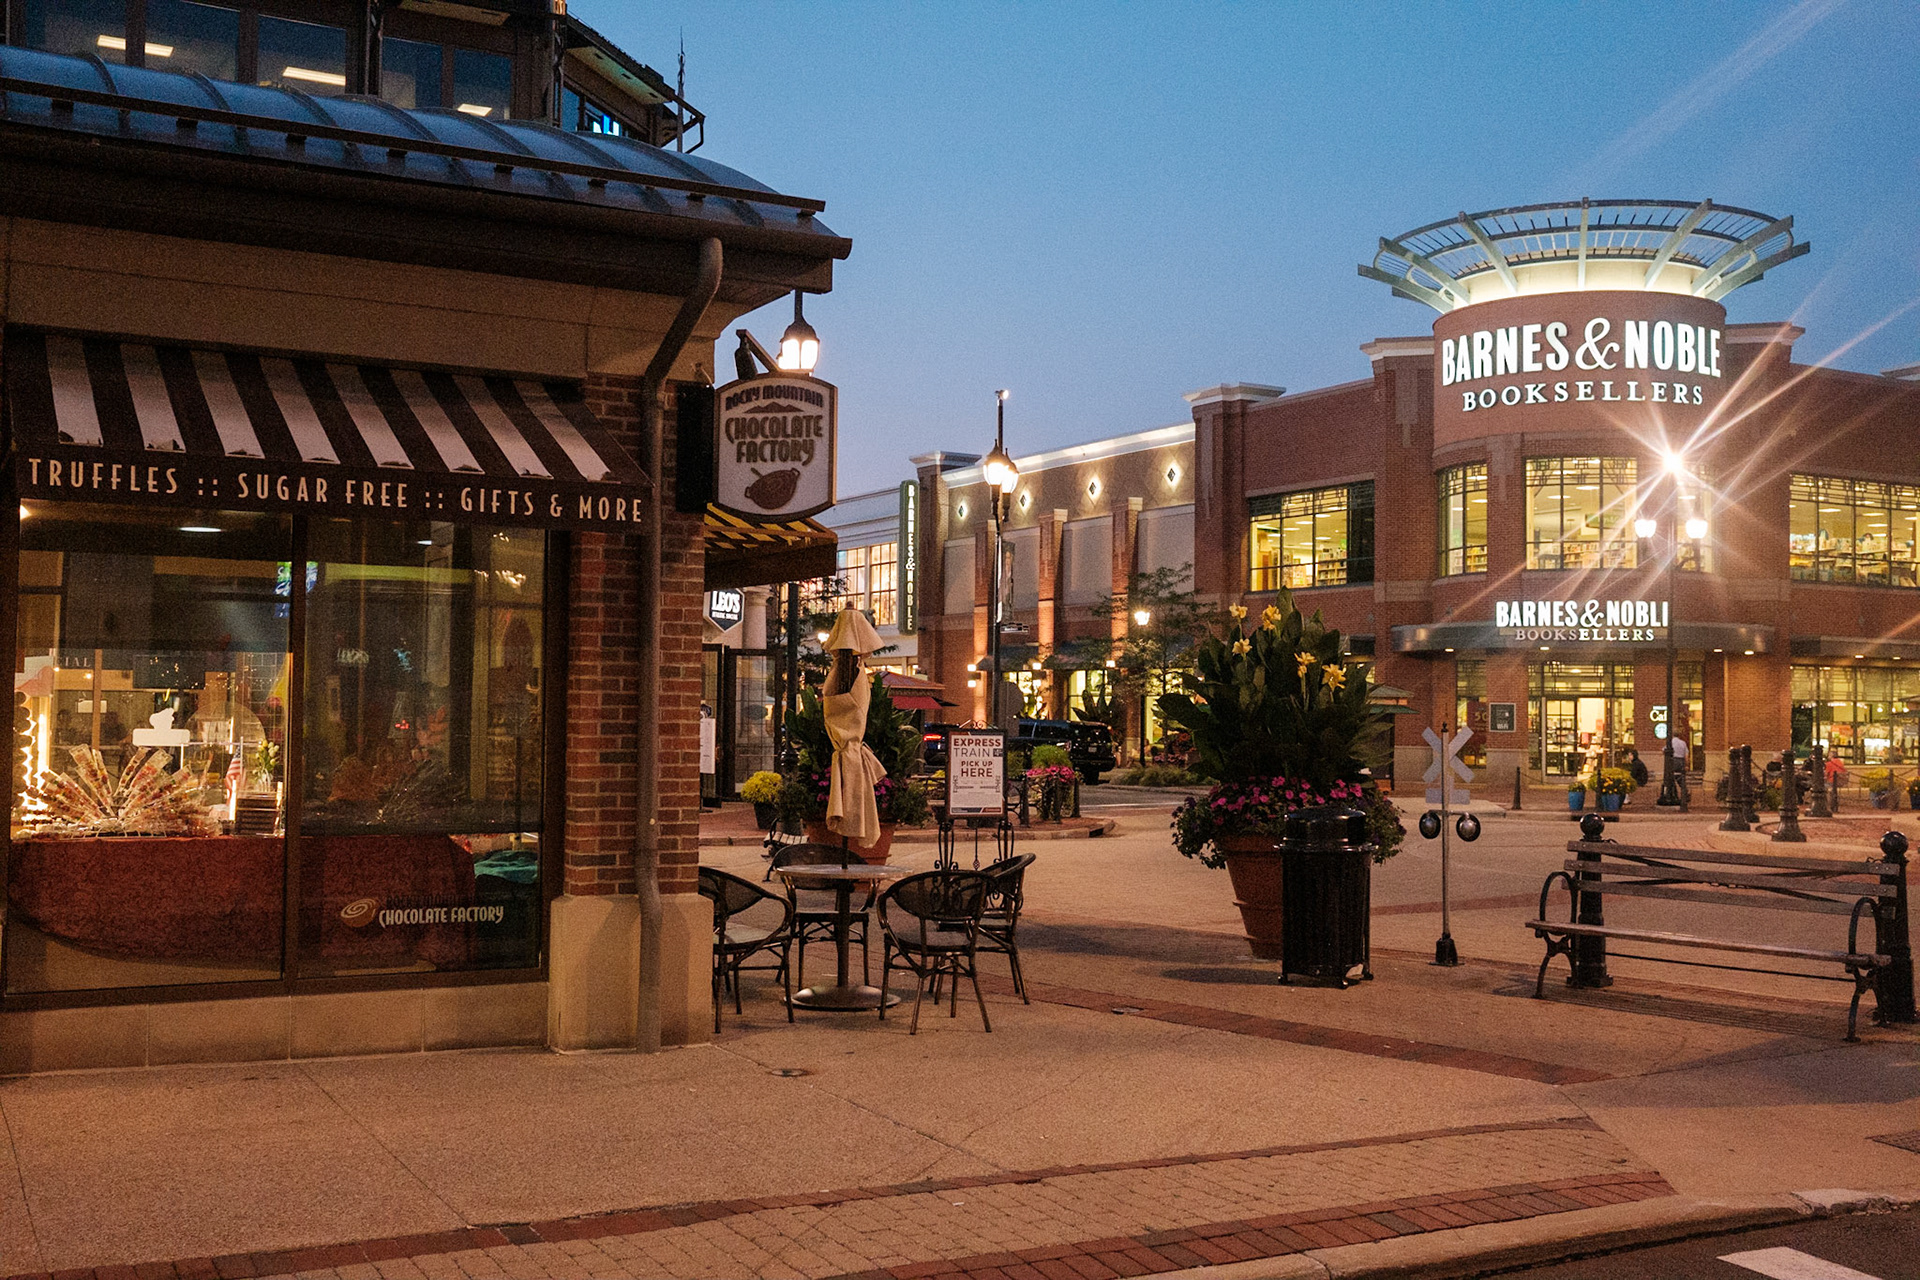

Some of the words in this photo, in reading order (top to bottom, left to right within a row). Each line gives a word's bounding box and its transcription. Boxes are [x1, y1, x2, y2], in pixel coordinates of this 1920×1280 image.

[725, 386, 760, 412] ROCKY
[762, 384, 824, 408] MOUNTAIN
[1462, 381, 1703, 412] BOOKSELLERS
[725, 414, 823, 444] CHOCOLATE
[736, 439, 815, 466] FACTORY
[28, 457, 178, 494] TRUFFLES
[238, 472, 328, 503] SUGAR
[346, 480, 407, 508] FREE
[460, 487, 534, 516] GIFTS
[550, 493, 563, 518] &
[578, 495, 642, 523] MORE
[1516, 628, 1655, 641] BOOKSELLERS
[953, 738, 1001, 747] EXPRESS
[953, 747, 990, 758] TRAIN
[961, 767, 993, 777] HERE
[378, 907, 447, 929] CHOCOLATE
[451, 905, 504, 924] FACTORY
